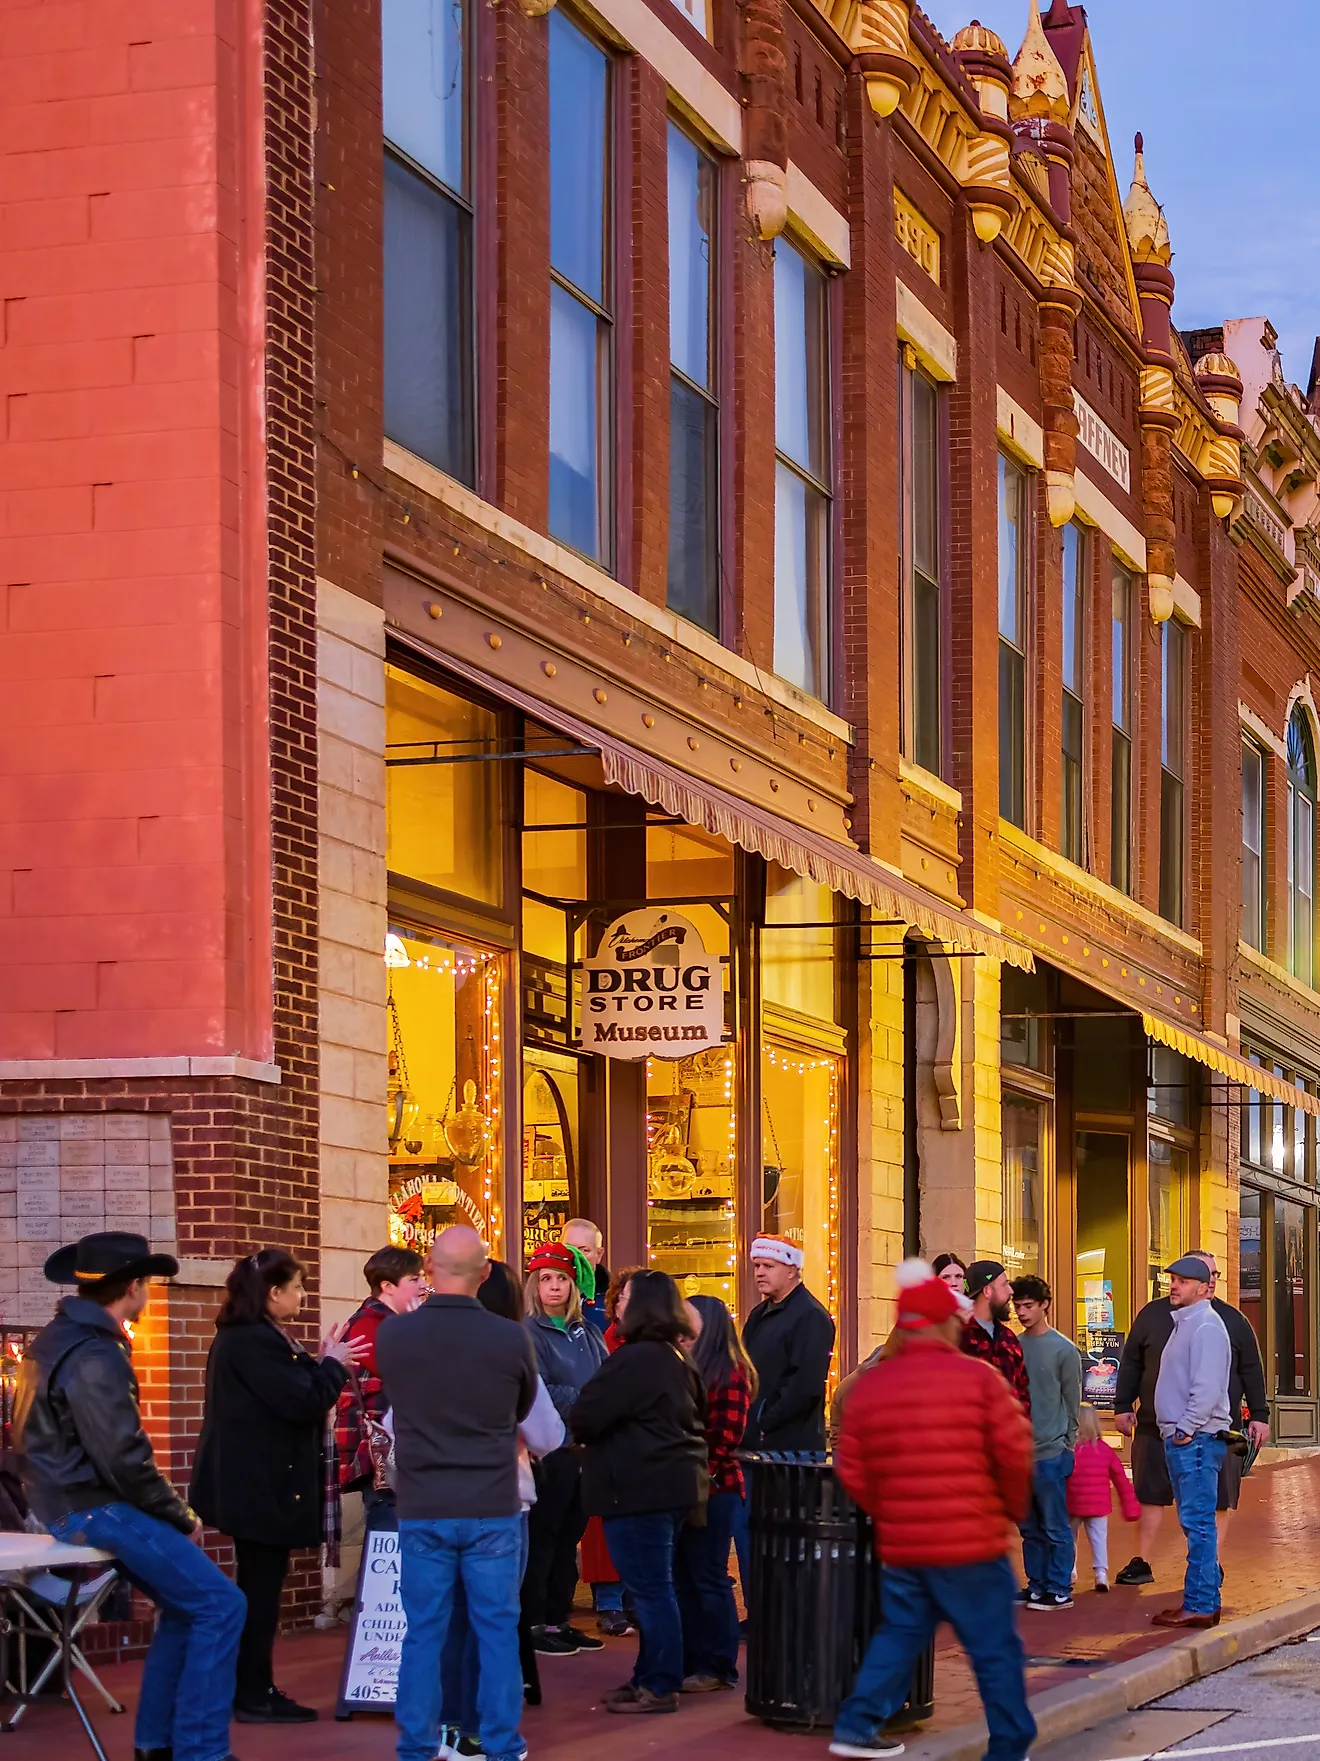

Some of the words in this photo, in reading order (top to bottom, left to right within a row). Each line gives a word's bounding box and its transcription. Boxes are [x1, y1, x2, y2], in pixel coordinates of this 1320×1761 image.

[1075, 403, 1127, 485] AFFNEY
[621, 928, 677, 960] FRONTIER
[586, 965, 711, 993] DRUG
[590, 995, 704, 1012] STORE
[593, 1023, 708, 1042] Museum
[405, 1222, 435, 1247] Drug
[524, 1228, 561, 1243] DRUG
